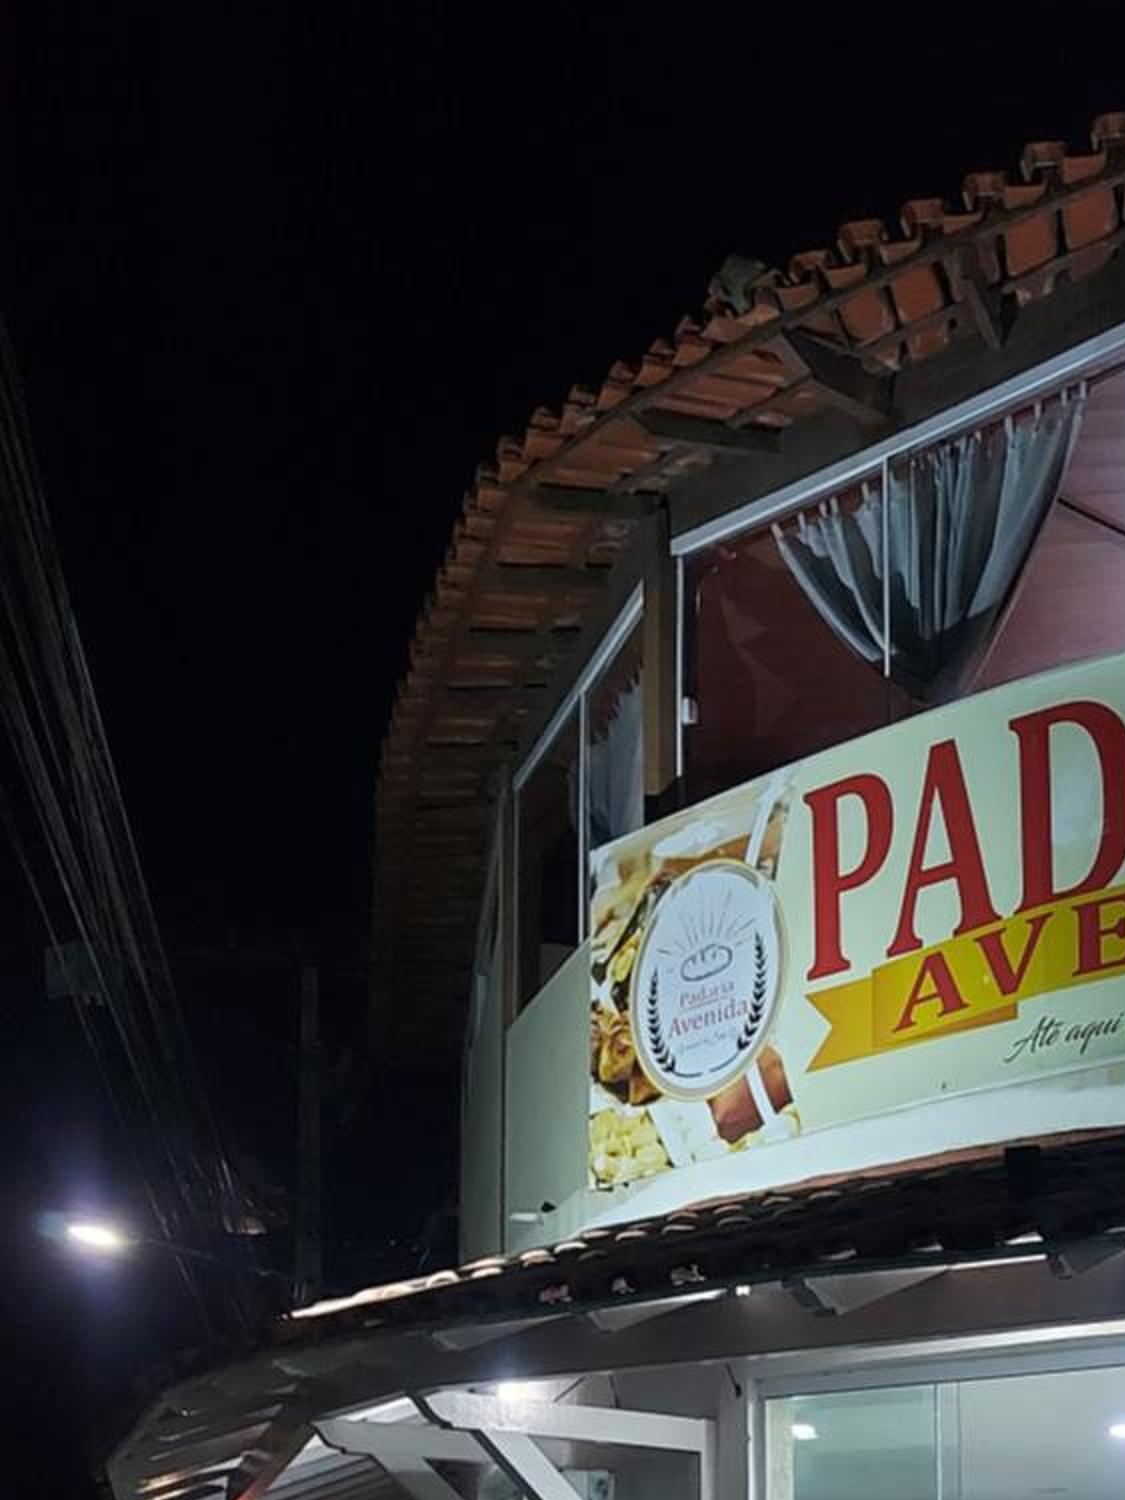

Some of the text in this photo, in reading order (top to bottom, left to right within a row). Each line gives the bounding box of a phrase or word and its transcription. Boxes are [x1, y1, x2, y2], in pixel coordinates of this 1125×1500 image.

[668, 998, 749, 1039] Avenida
[1003, 1014, 1063, 1063] Até
[1065, 1012, 1125, 1055] aqui
